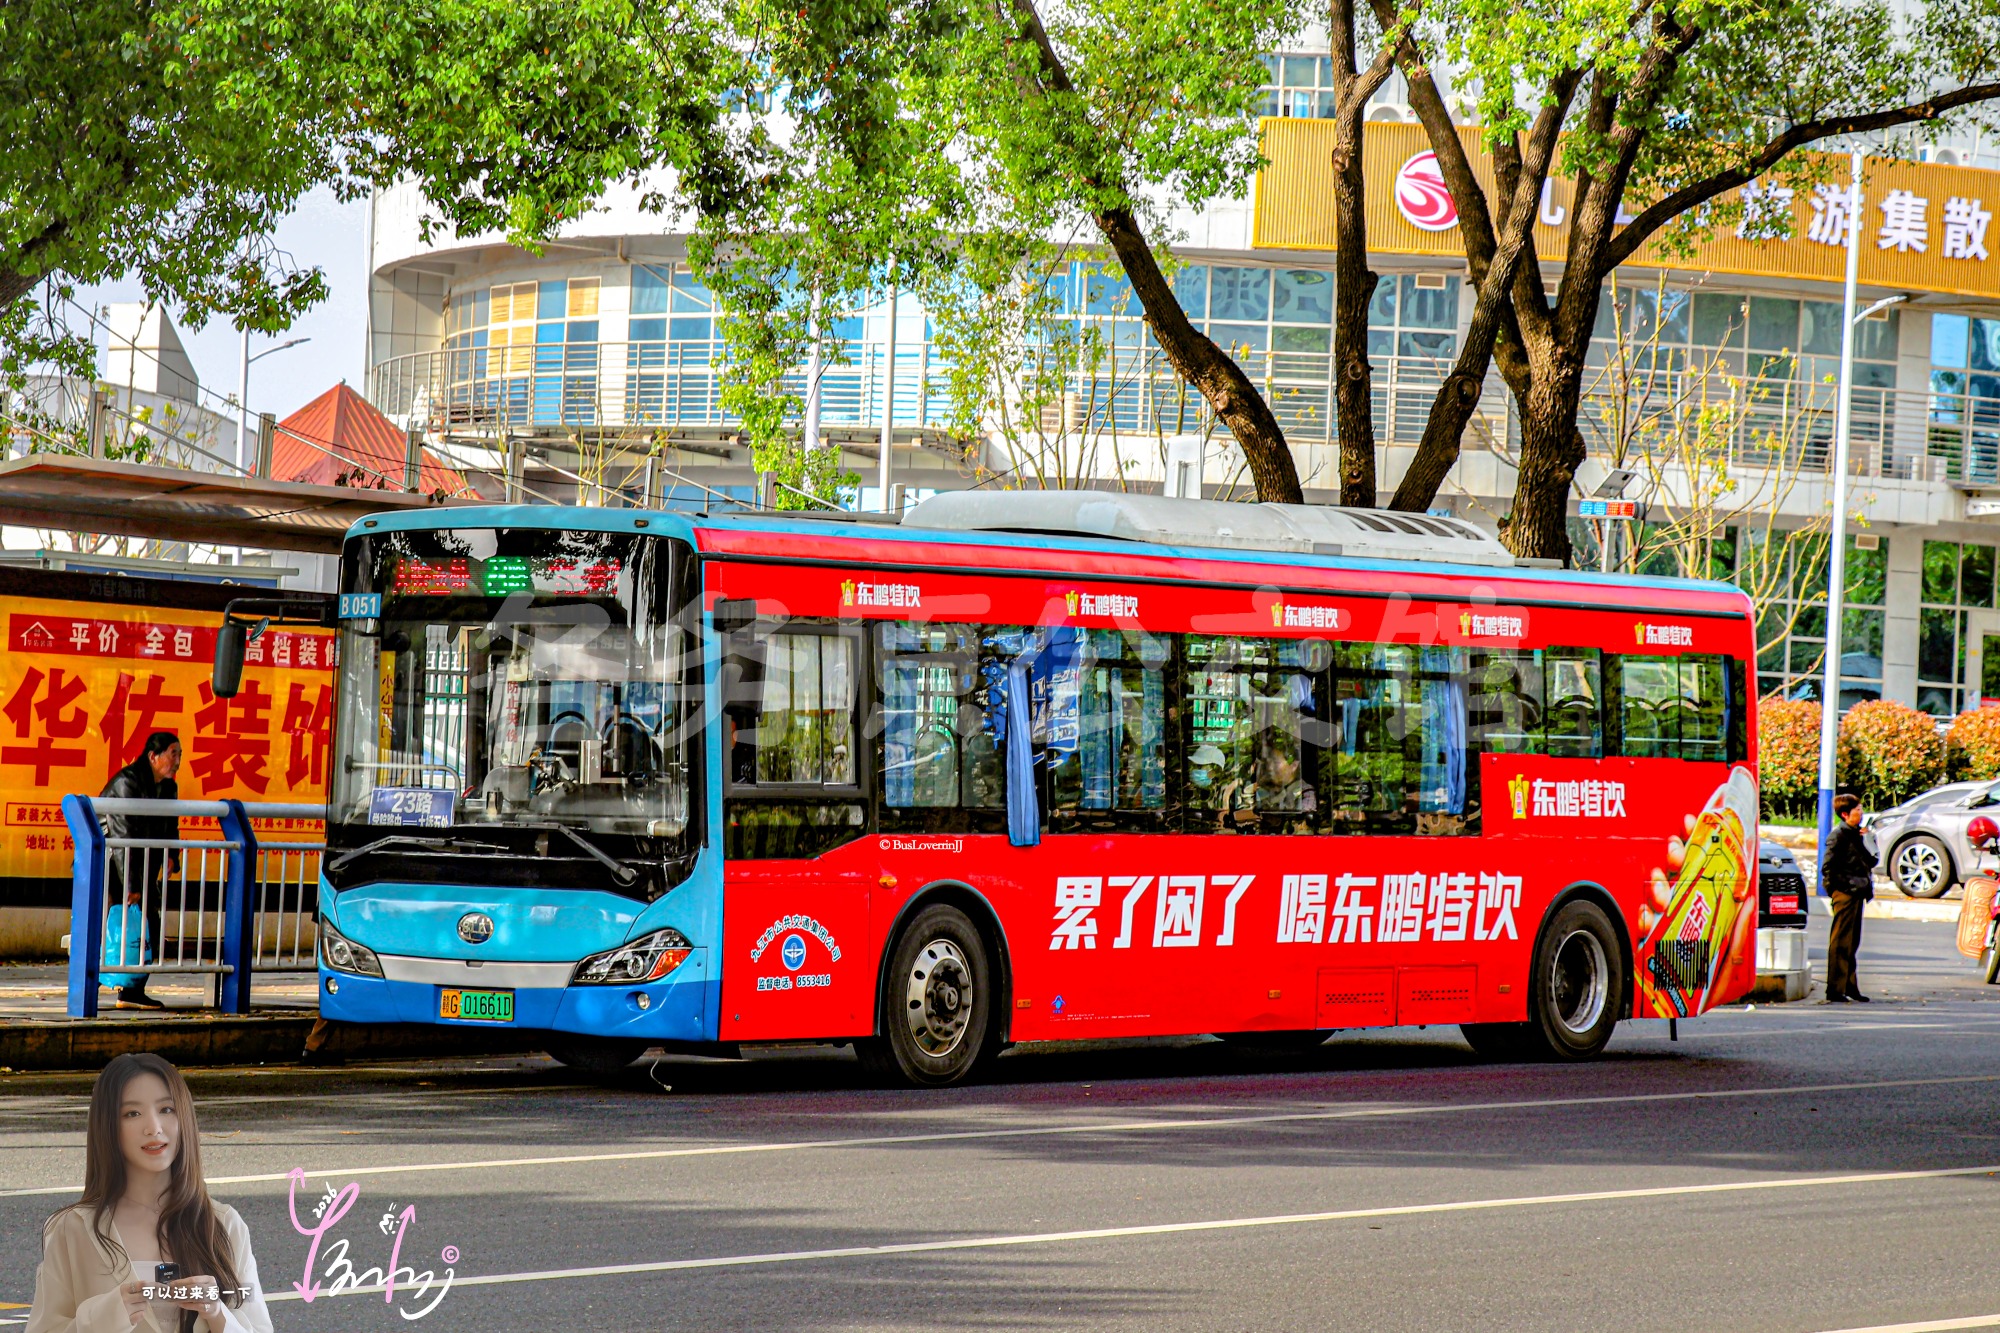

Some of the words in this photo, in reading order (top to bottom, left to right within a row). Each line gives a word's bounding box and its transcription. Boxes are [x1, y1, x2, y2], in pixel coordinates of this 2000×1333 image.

[341, 596, 349, 615] B
[352, 596, 377, 615] 051
[856, 581, 921, 608] 东鹏特饮
[1080, 592, 1139, 618] 东鹏特饮
[1284, 604, 1339, 629] 东鹏特饮
[1470, 613, 1523, 638] 东鹏特饮
[69, 622, 120, 653] 平价
[145, 627, 193, 657] 全包
[1645, 623, 1694, 647] 东鹏特饮
[391, 791, 433, 815] 23路
[1532, 778, 1627, 818] 东鹏特饮
[1048, 875, 1257, 951] 累了困了
[1276, 870, 1524, 945] 喝东鹏特饮
[751, 914, 842, 963] 九江市公共交通集团公司
[796, 974, 832, 988] 8553416
